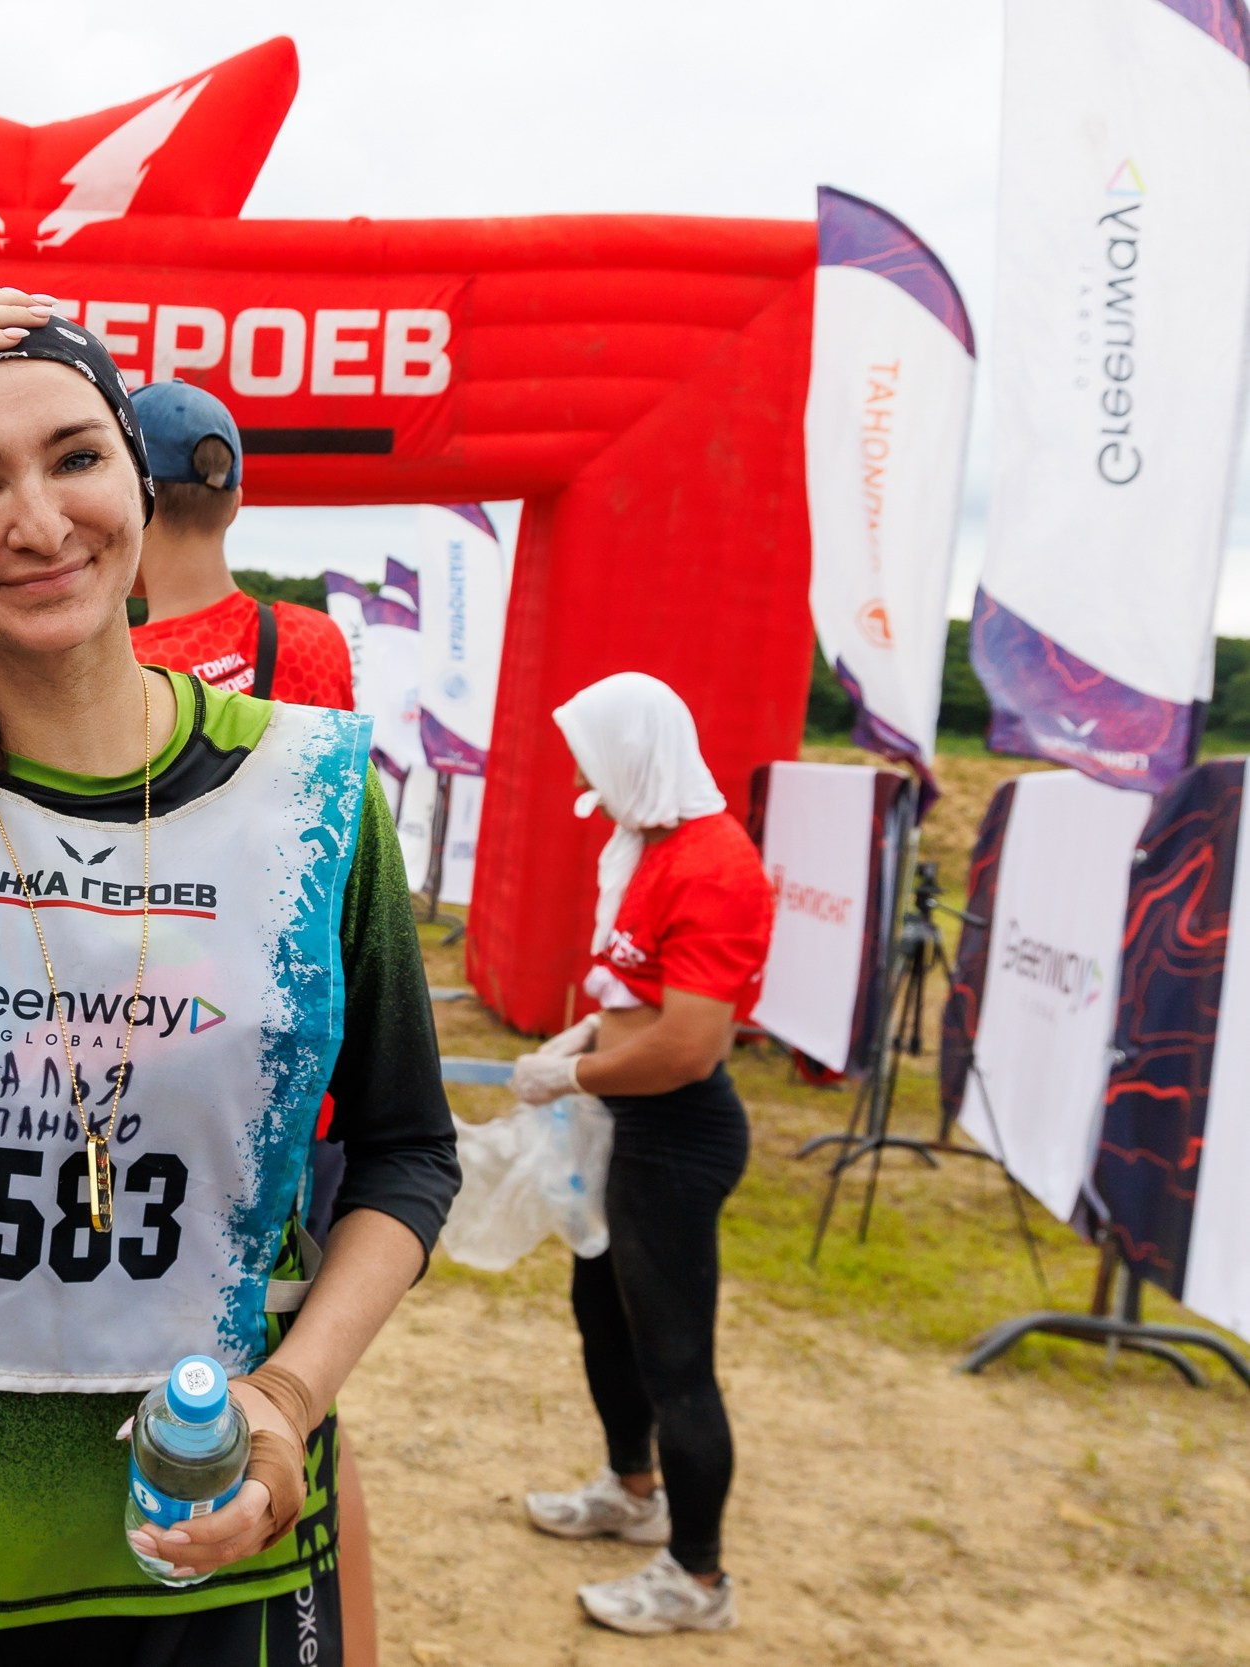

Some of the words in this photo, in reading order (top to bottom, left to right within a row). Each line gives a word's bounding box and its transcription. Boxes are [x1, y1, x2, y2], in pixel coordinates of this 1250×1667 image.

[57, 299, 452, 397] ЕРОЕВ
[81, 878, 217, 909] ГЕРОЕВ
[0, 1030, 125, 1050] GLOBAL
